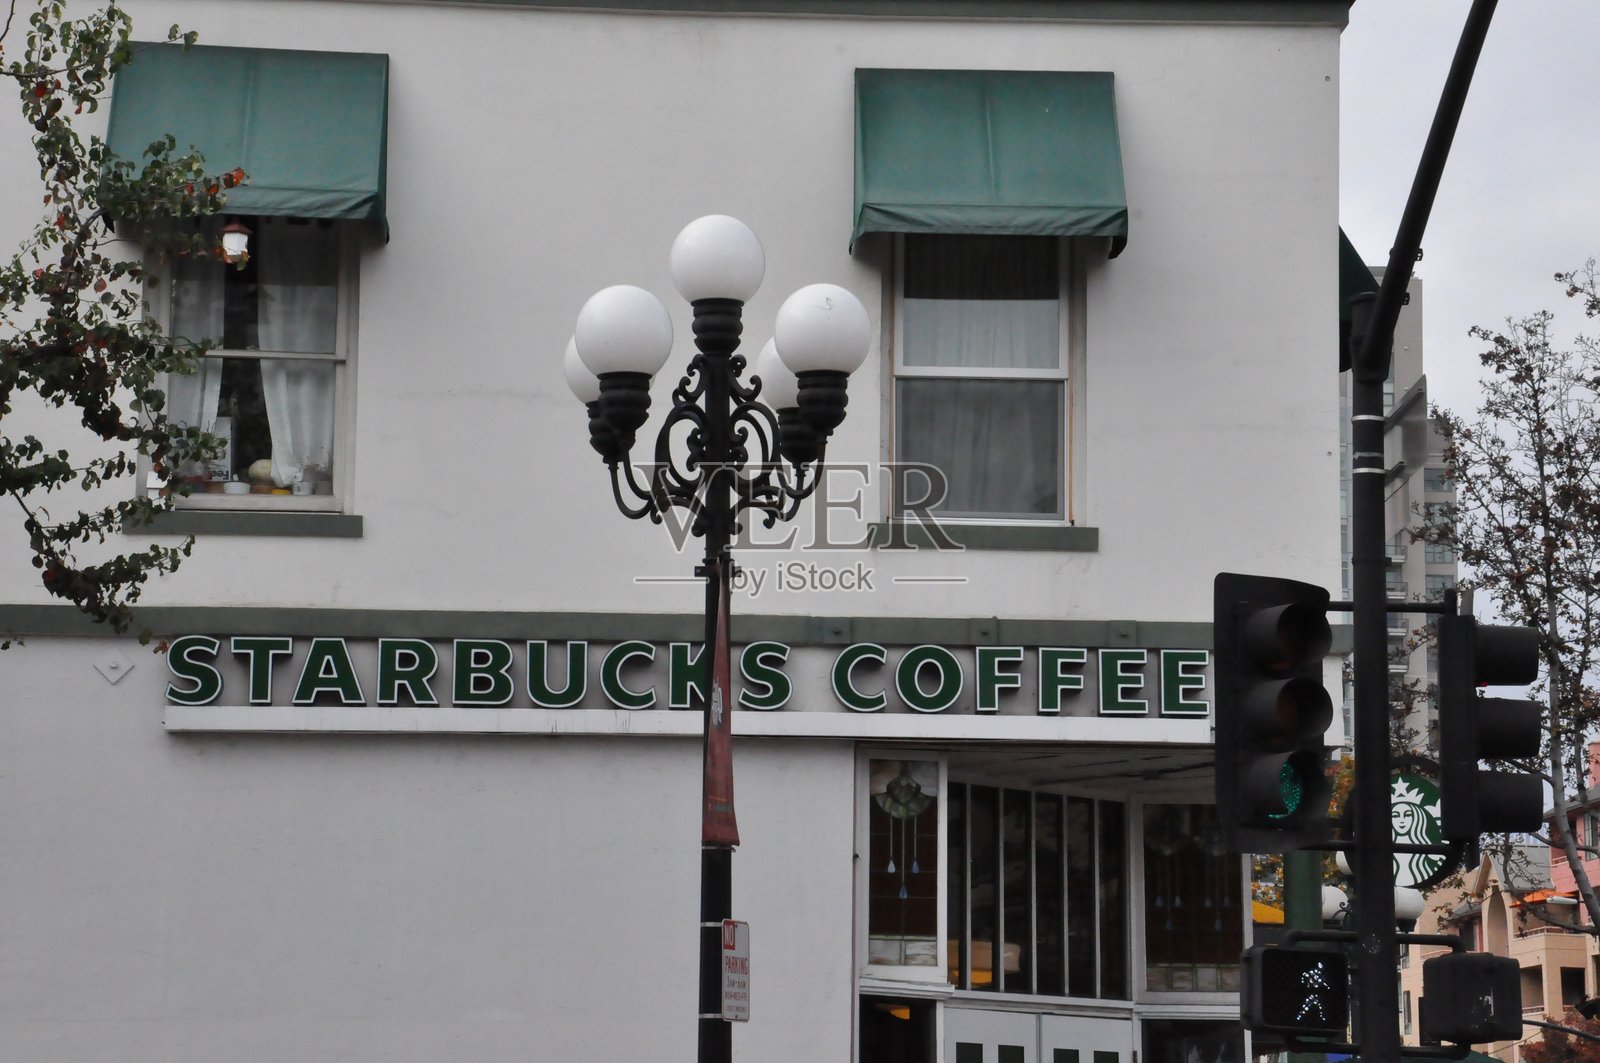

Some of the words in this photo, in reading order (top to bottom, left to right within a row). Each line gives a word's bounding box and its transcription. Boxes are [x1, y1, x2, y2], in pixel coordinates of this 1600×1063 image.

[165, 635, 793, 711] STARBUCKS
[832, 642, 1210, 715] COFFEE
[724, 924, 735, 946] NO
[725, 956, 749, 977] PARKING
